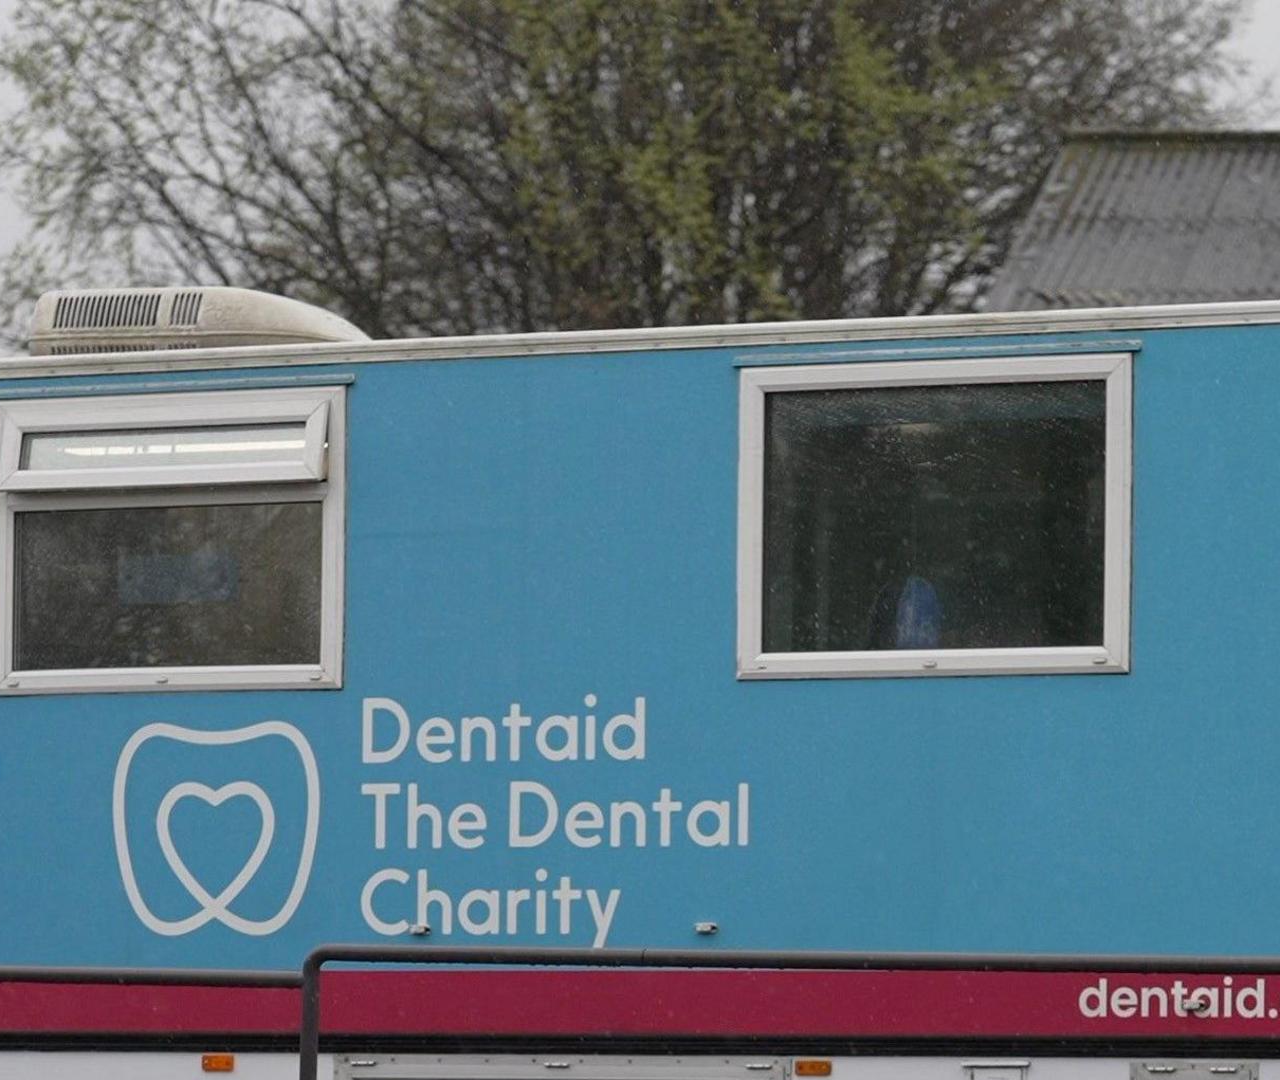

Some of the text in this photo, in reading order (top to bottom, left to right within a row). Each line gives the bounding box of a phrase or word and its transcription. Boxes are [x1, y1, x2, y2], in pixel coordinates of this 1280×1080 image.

[361, 693, 646, 765] Dentaid
[361, 780, 750, 850] The Dental
[360, 867, 621, 950] Charity
